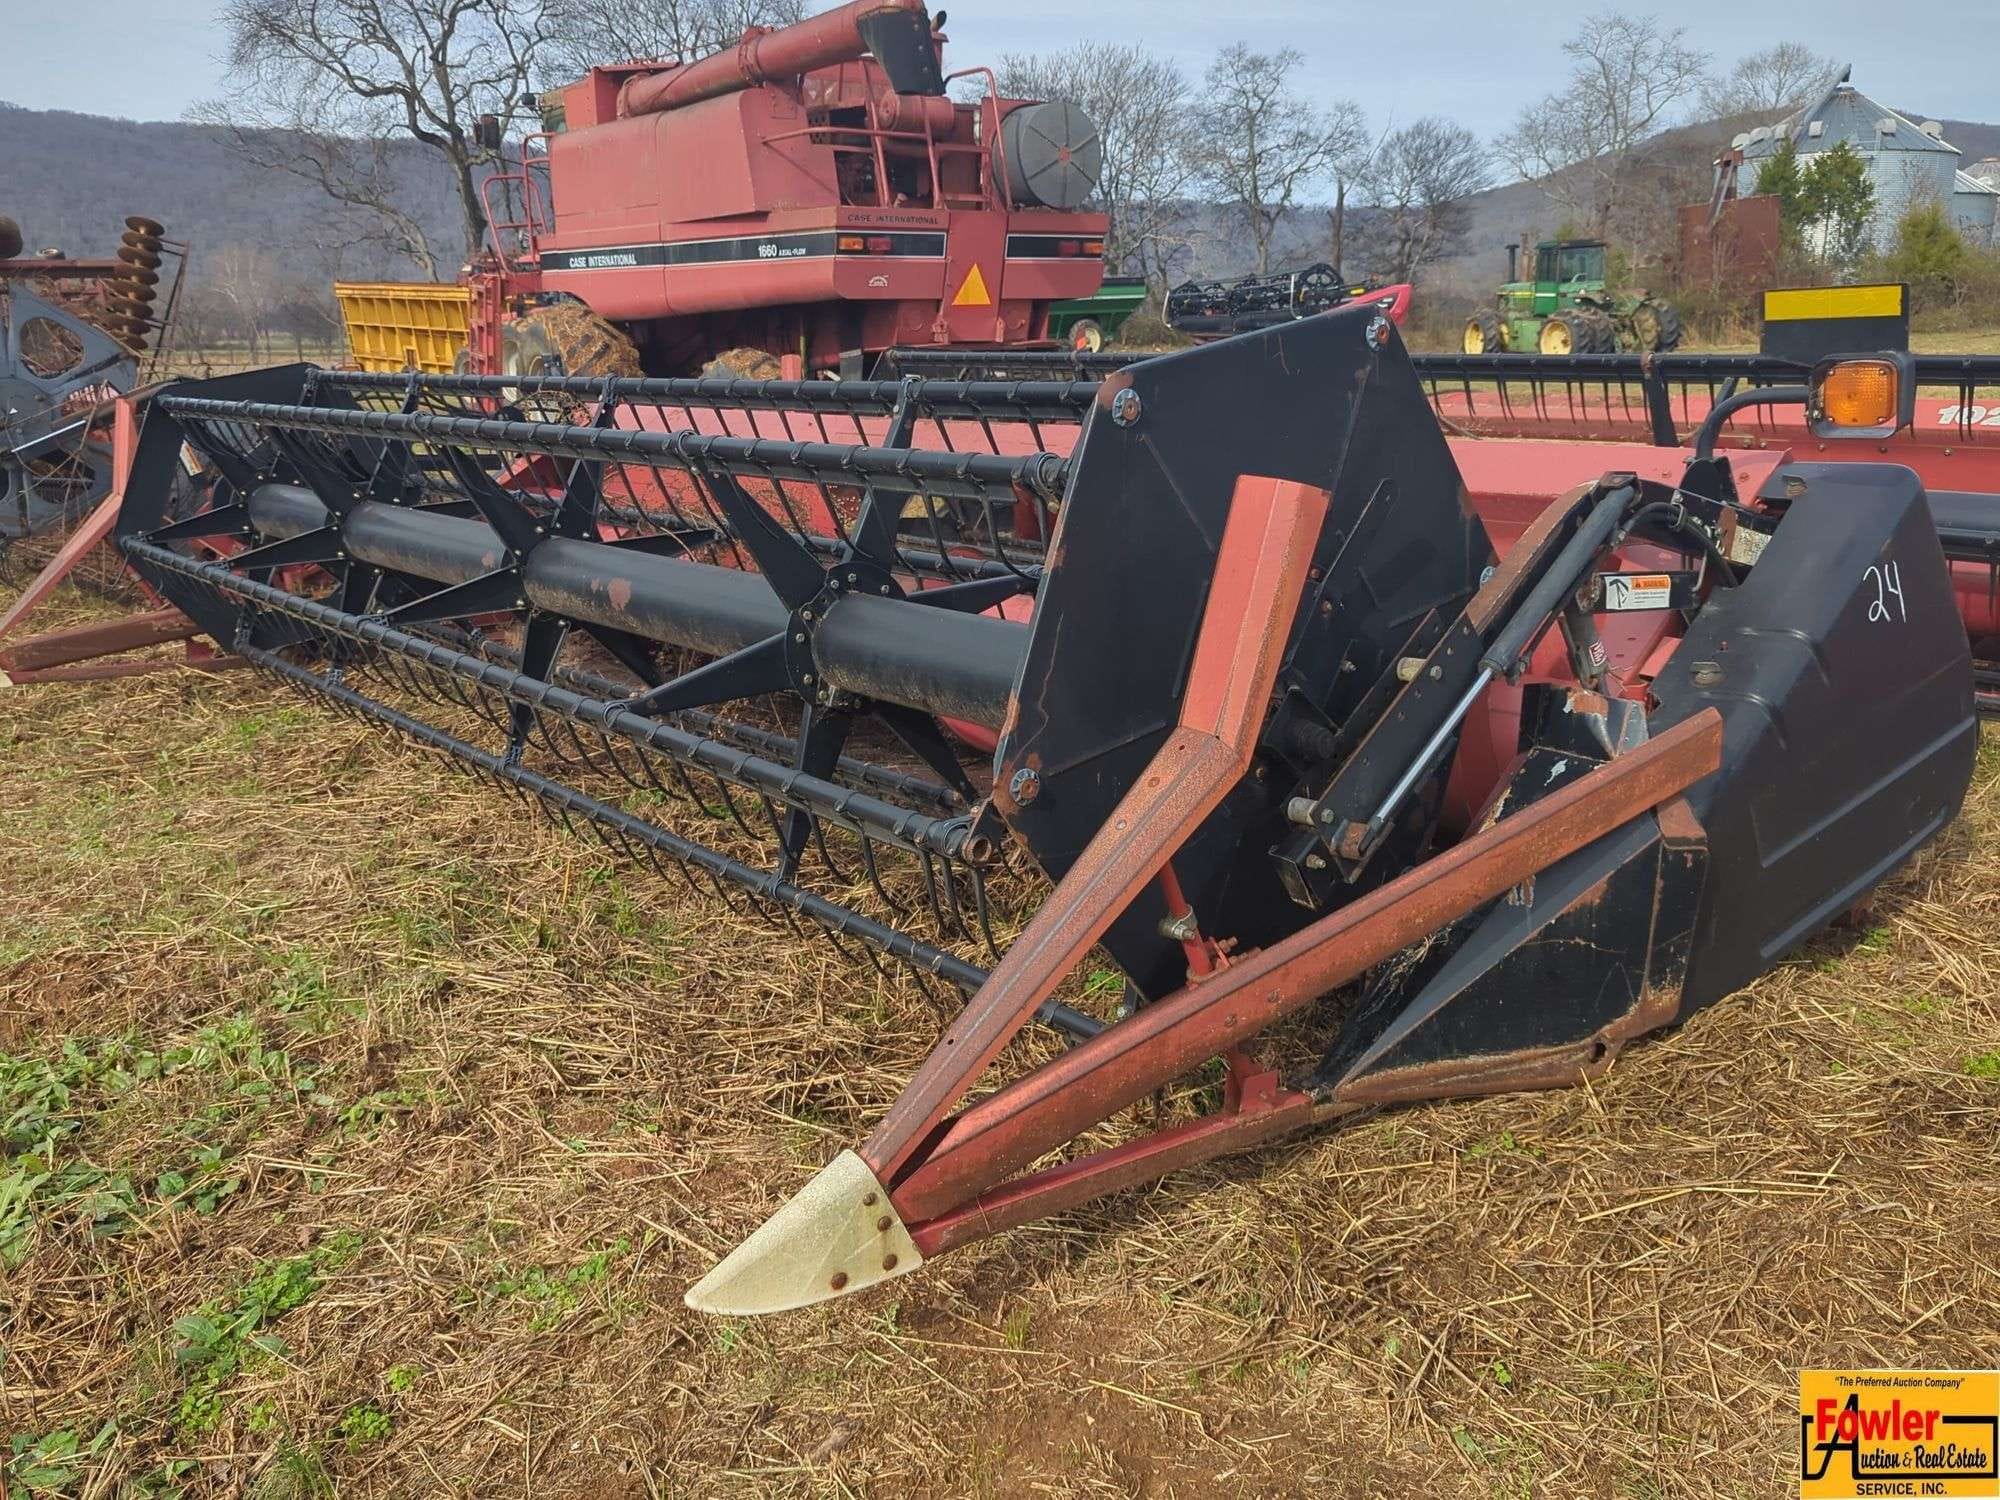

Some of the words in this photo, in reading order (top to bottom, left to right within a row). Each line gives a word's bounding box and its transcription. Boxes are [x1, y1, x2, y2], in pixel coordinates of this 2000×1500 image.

[847, 213, 872, 223] CASE
[873, 213, 939, 225] INTERNATIONAL
[758, 244, 778, 258] 1660
[568, 256, 587, 268] CASE
[588, 253, 637, 267] INTERNATIONAL
[1862, 560, 1907, 623] 24
